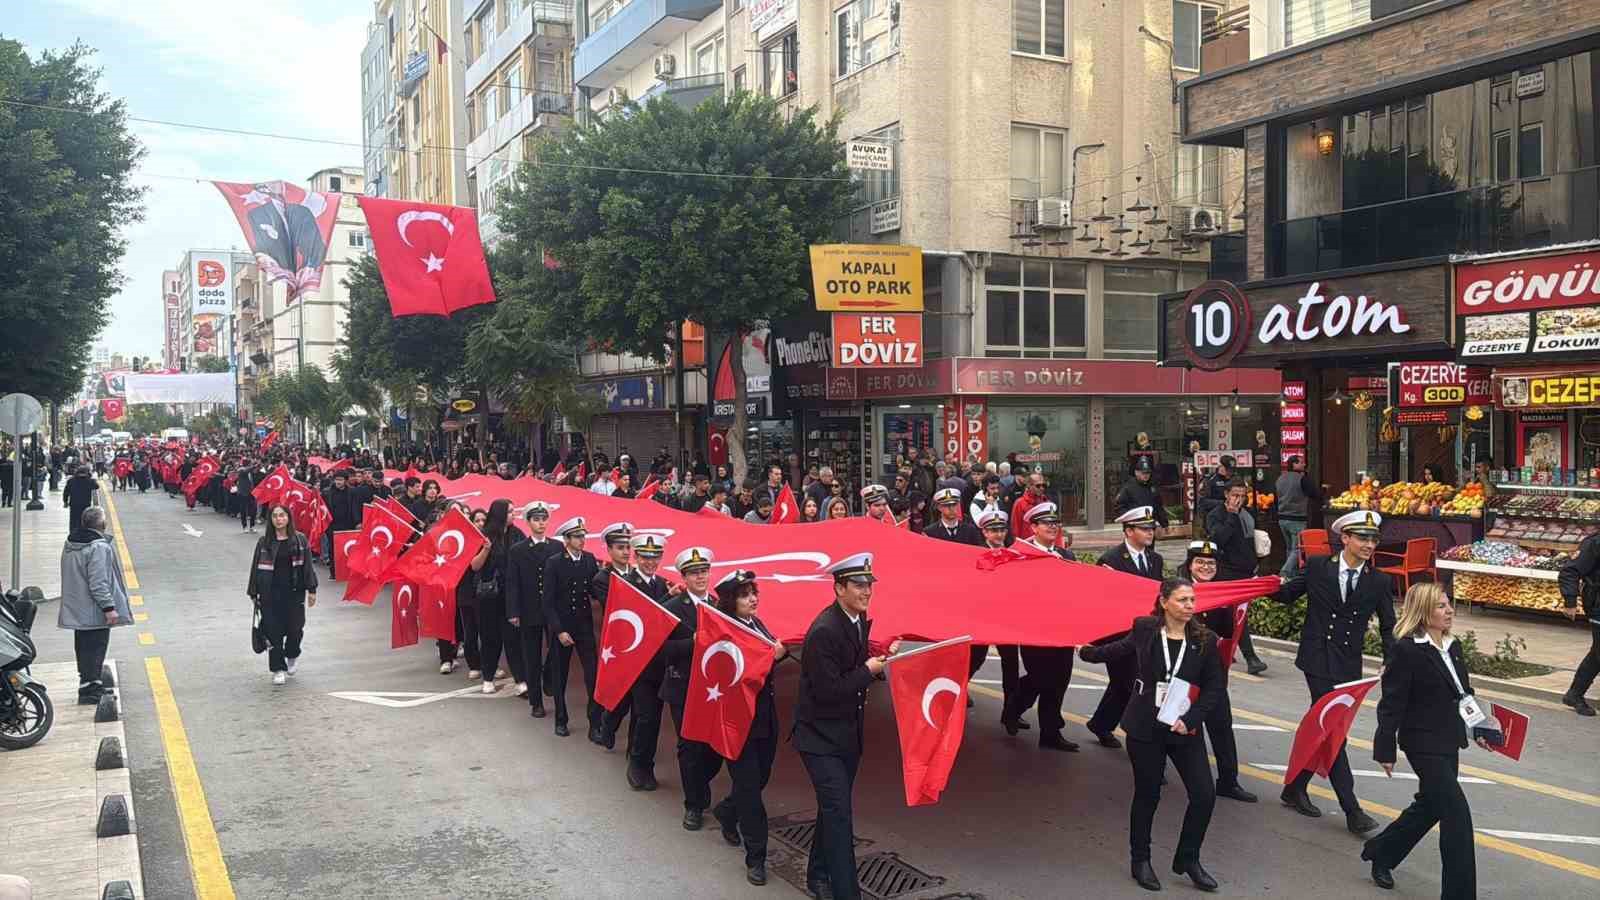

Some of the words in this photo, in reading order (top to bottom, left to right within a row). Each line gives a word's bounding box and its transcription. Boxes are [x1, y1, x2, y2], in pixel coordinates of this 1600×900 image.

[852, 145, 888, 154] AVUKAT
[841, 262, 896, 275] KAPALI
[198, 288, 225, 297] dodo
[826, 280, 861, 294] OTO
[867, 281, 912, 295] PARK
[199, 296, 226, 306] pizza
[1191, 300, 1232, 347] 10
[1258, 282, 1411, 344] atom
[861, 316, 896, 334] FER
[1468, 342, 1521, 354] CEZERYE
[1538, 337, 1600, 349] LOKUM
[840, 338, 918, 364] DÖVİZ
[1024, 367, 1084, 385] DÖVİZ
[1400, 364, 1467, 384] CEZERYE
[1283, 387, 1304, 397] ATOM
[1281, 430, 1305, 443] ŞALGAM
